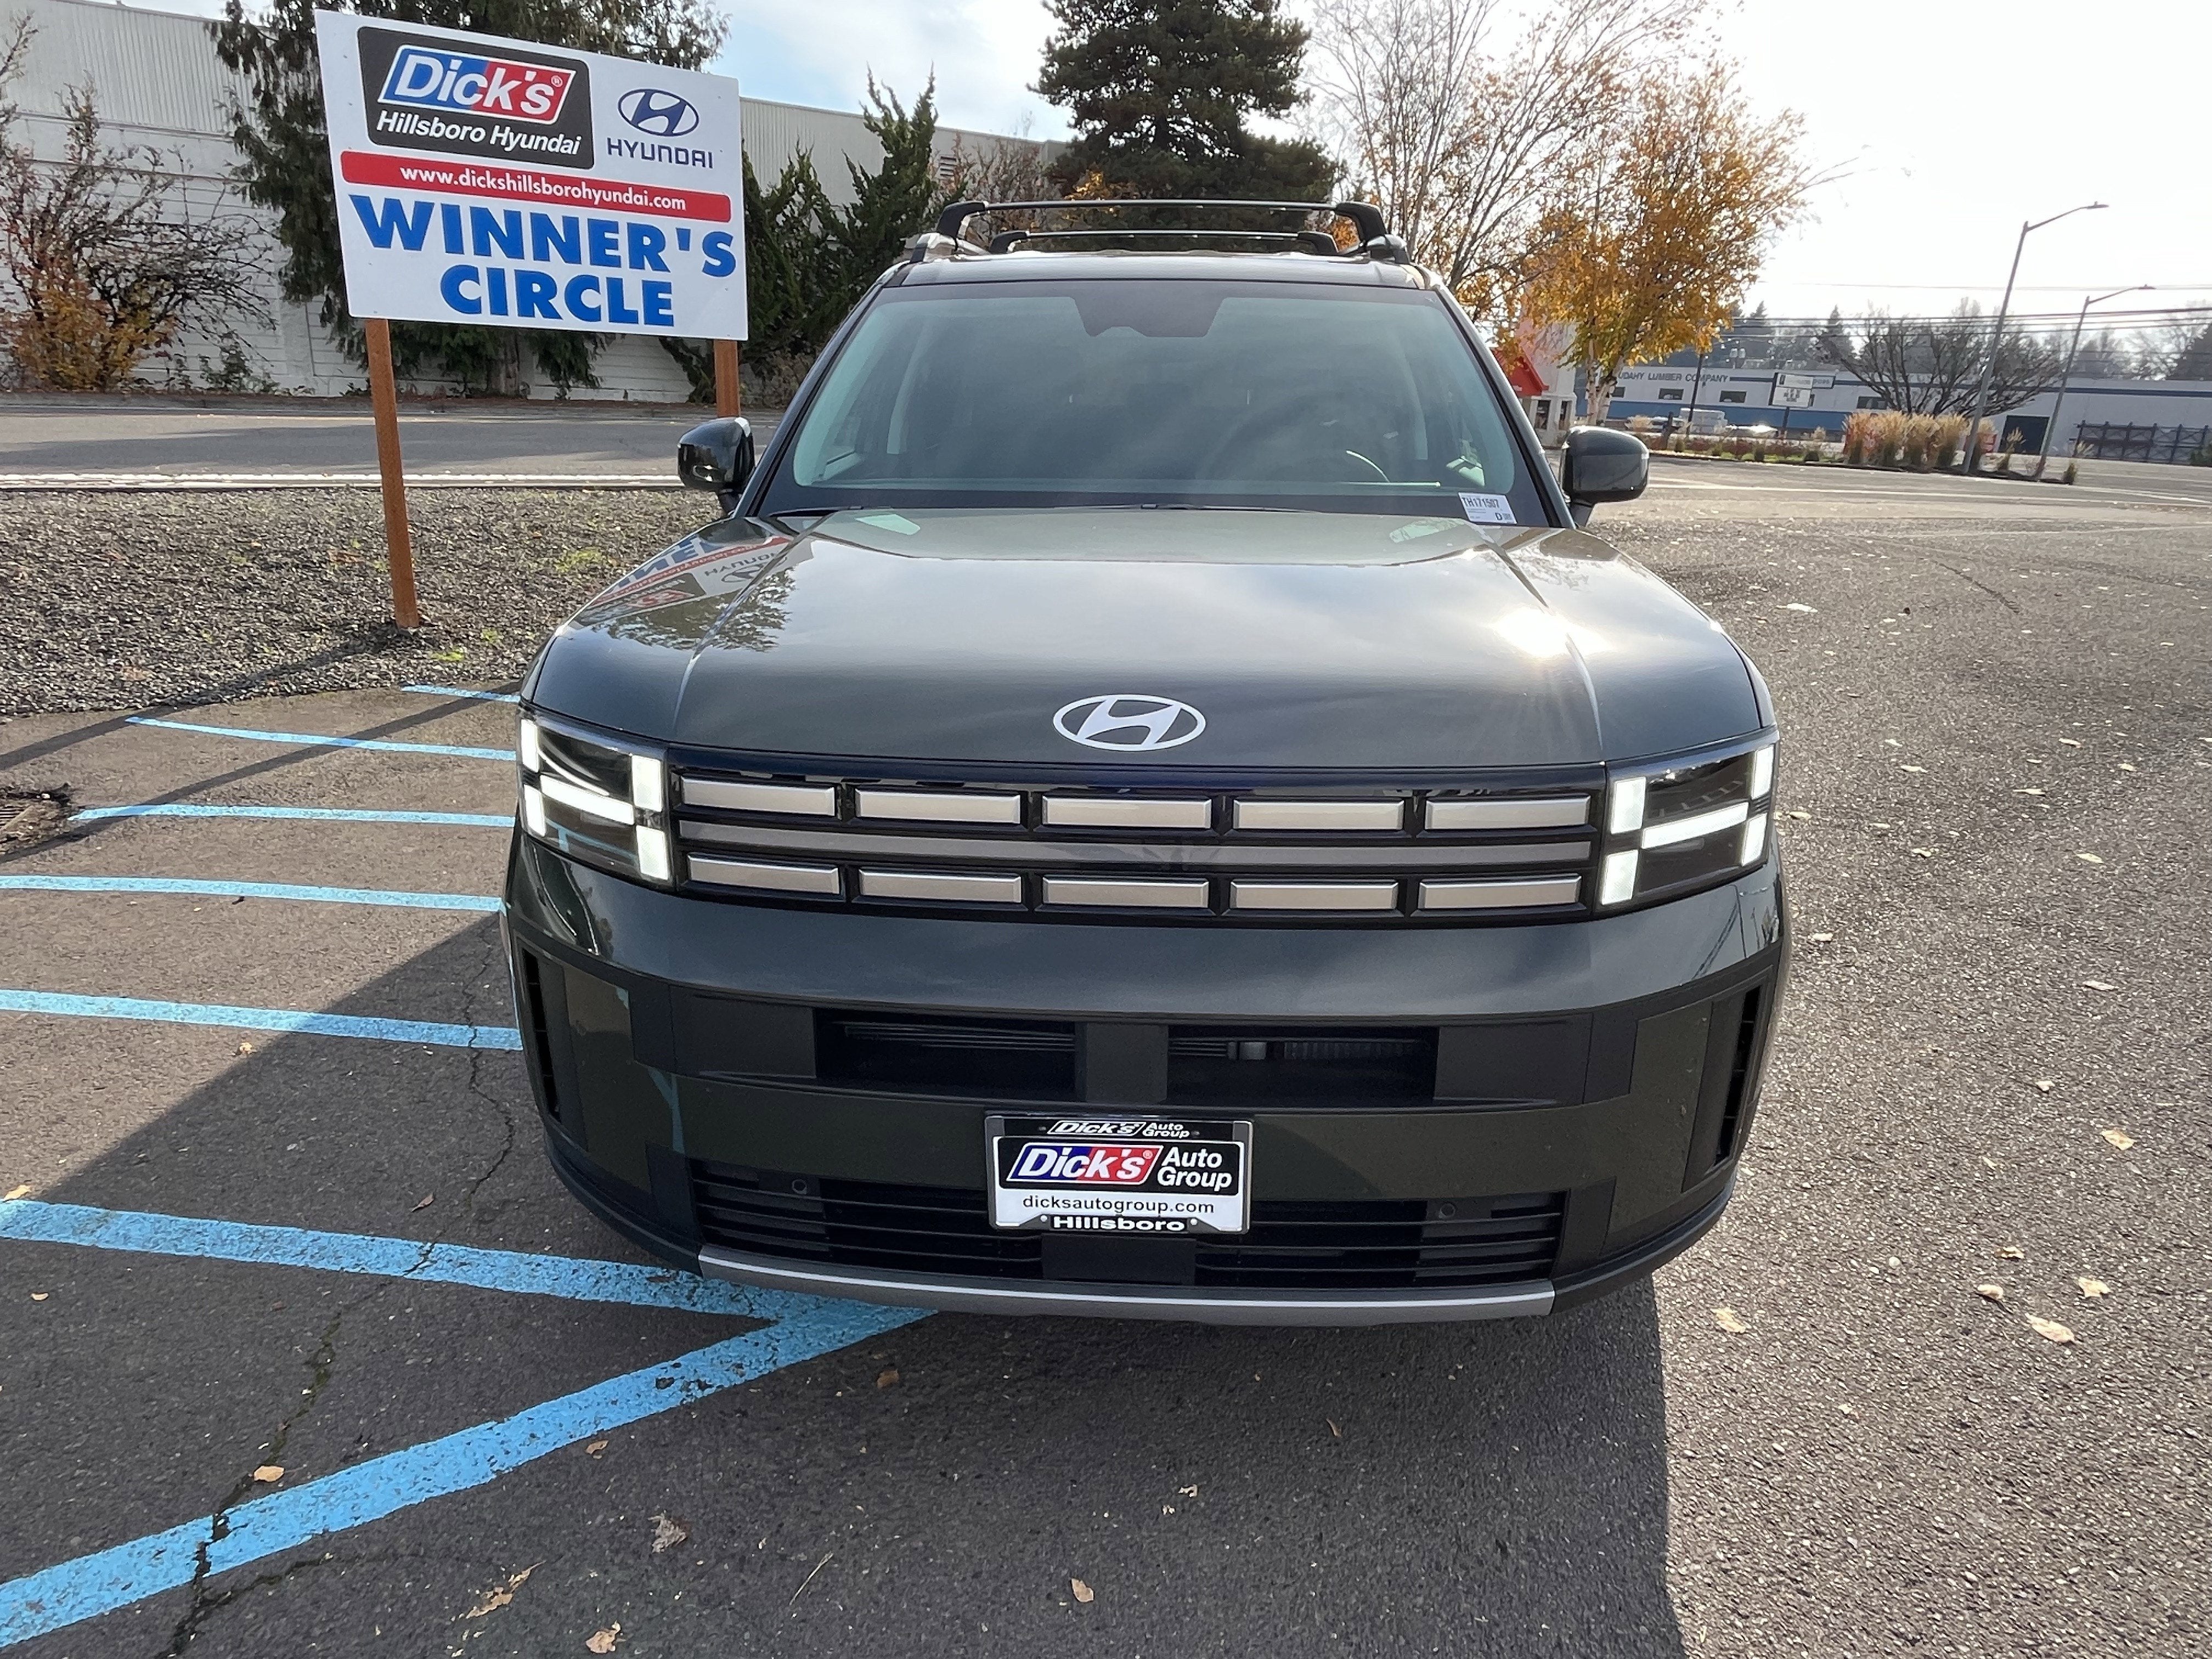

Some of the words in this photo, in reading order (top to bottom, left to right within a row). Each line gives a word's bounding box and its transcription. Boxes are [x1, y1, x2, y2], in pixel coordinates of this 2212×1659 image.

[394, 54, 554, 115] Dick's
[376, 110, 486, 143] Hillsboro
[489, 125, 582, 155] Hyundai
[607, 137, 714, 169] HYUNDAI
[400, 166, 686, 211] www.dickshillsborohyundai.com
[348, 194, 737, 278] WINNER'S
[440, 264, 674, 328] CIRCLE
[1648, 373, 1682, 381] LUMBER
[1054, 1121, 1138, 1135] Dick's
[1142, 1130, 1190, 1138] Group
[1146, 1122, 1184, 1131] Auto
[1018, 1147, 1145, 1180] Dick's
[1162, 1147, 1222, 1168] Auto
[1157, 1167, 1232, 1192] Group
[1023, 1195, 1215, 1214] dicksautogroup.com
[1053, 1216, 1186, 1231] Hillsboro
